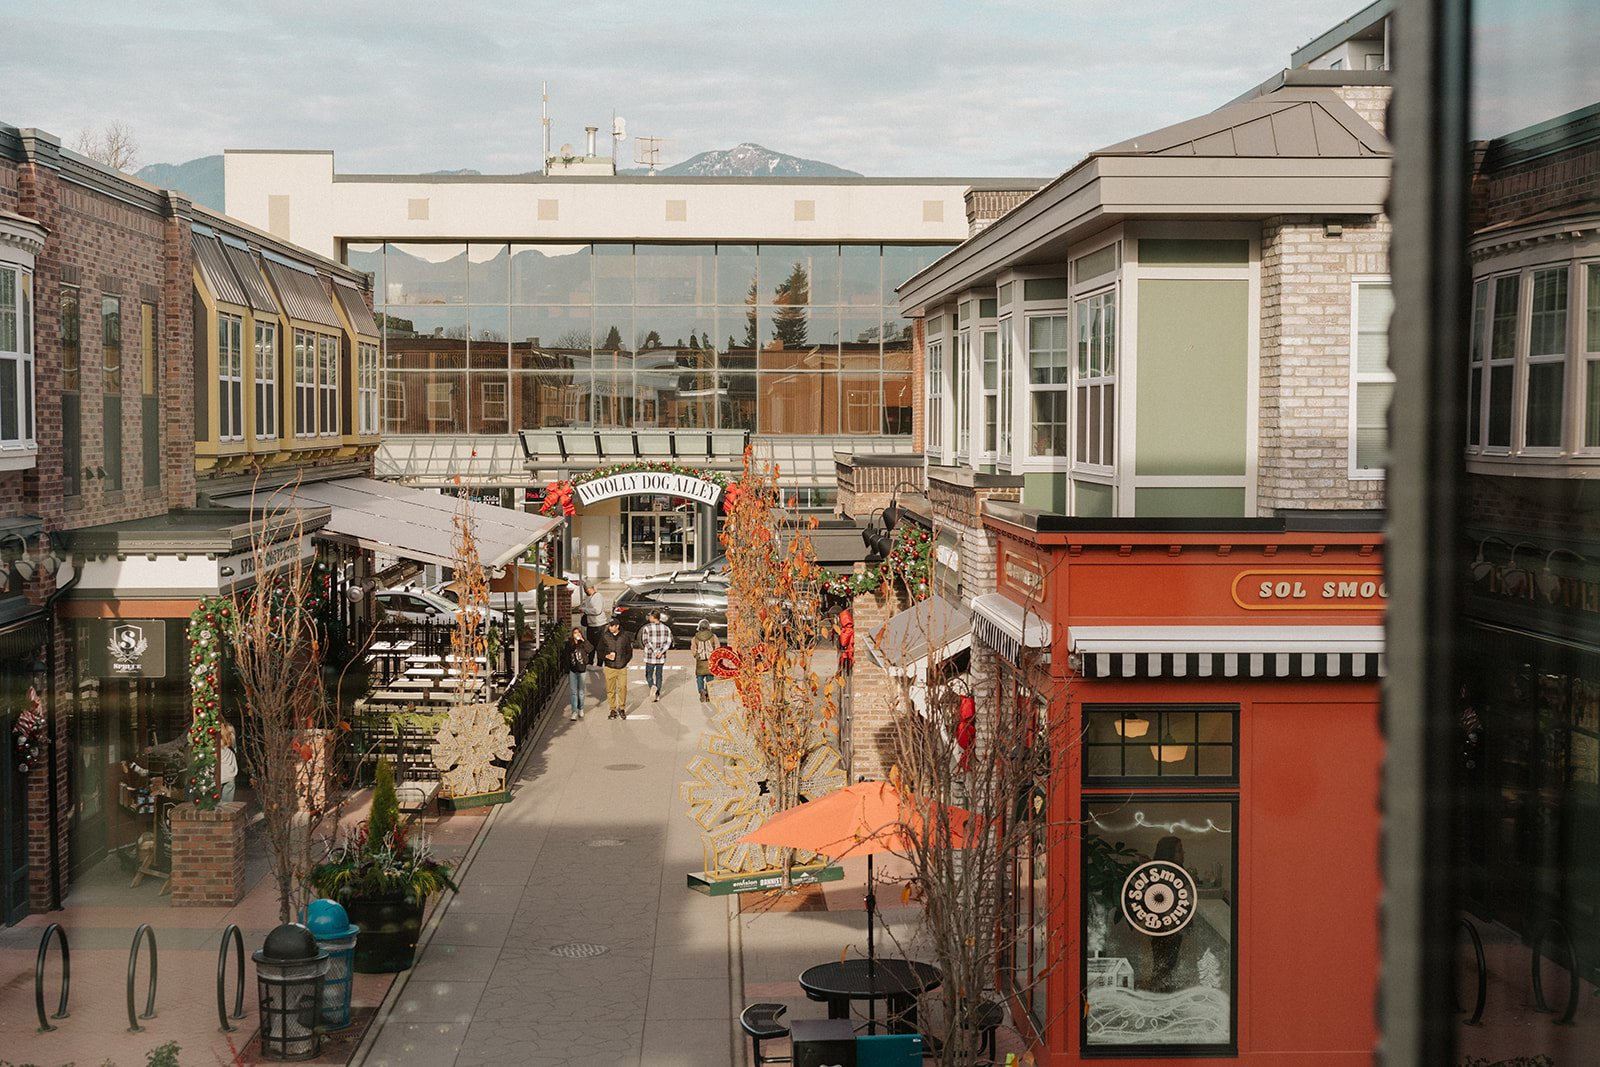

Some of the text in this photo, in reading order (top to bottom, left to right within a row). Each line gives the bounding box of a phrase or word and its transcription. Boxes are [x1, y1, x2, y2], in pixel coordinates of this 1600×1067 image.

[580, 474, 719, 501] WOOLLY DOG ALLEY
[1259, 581, 1306, 598] SOL
[120, 630, 136, 649] S
[1128, 868, 1190, 929] Sol Smoothie Bar
